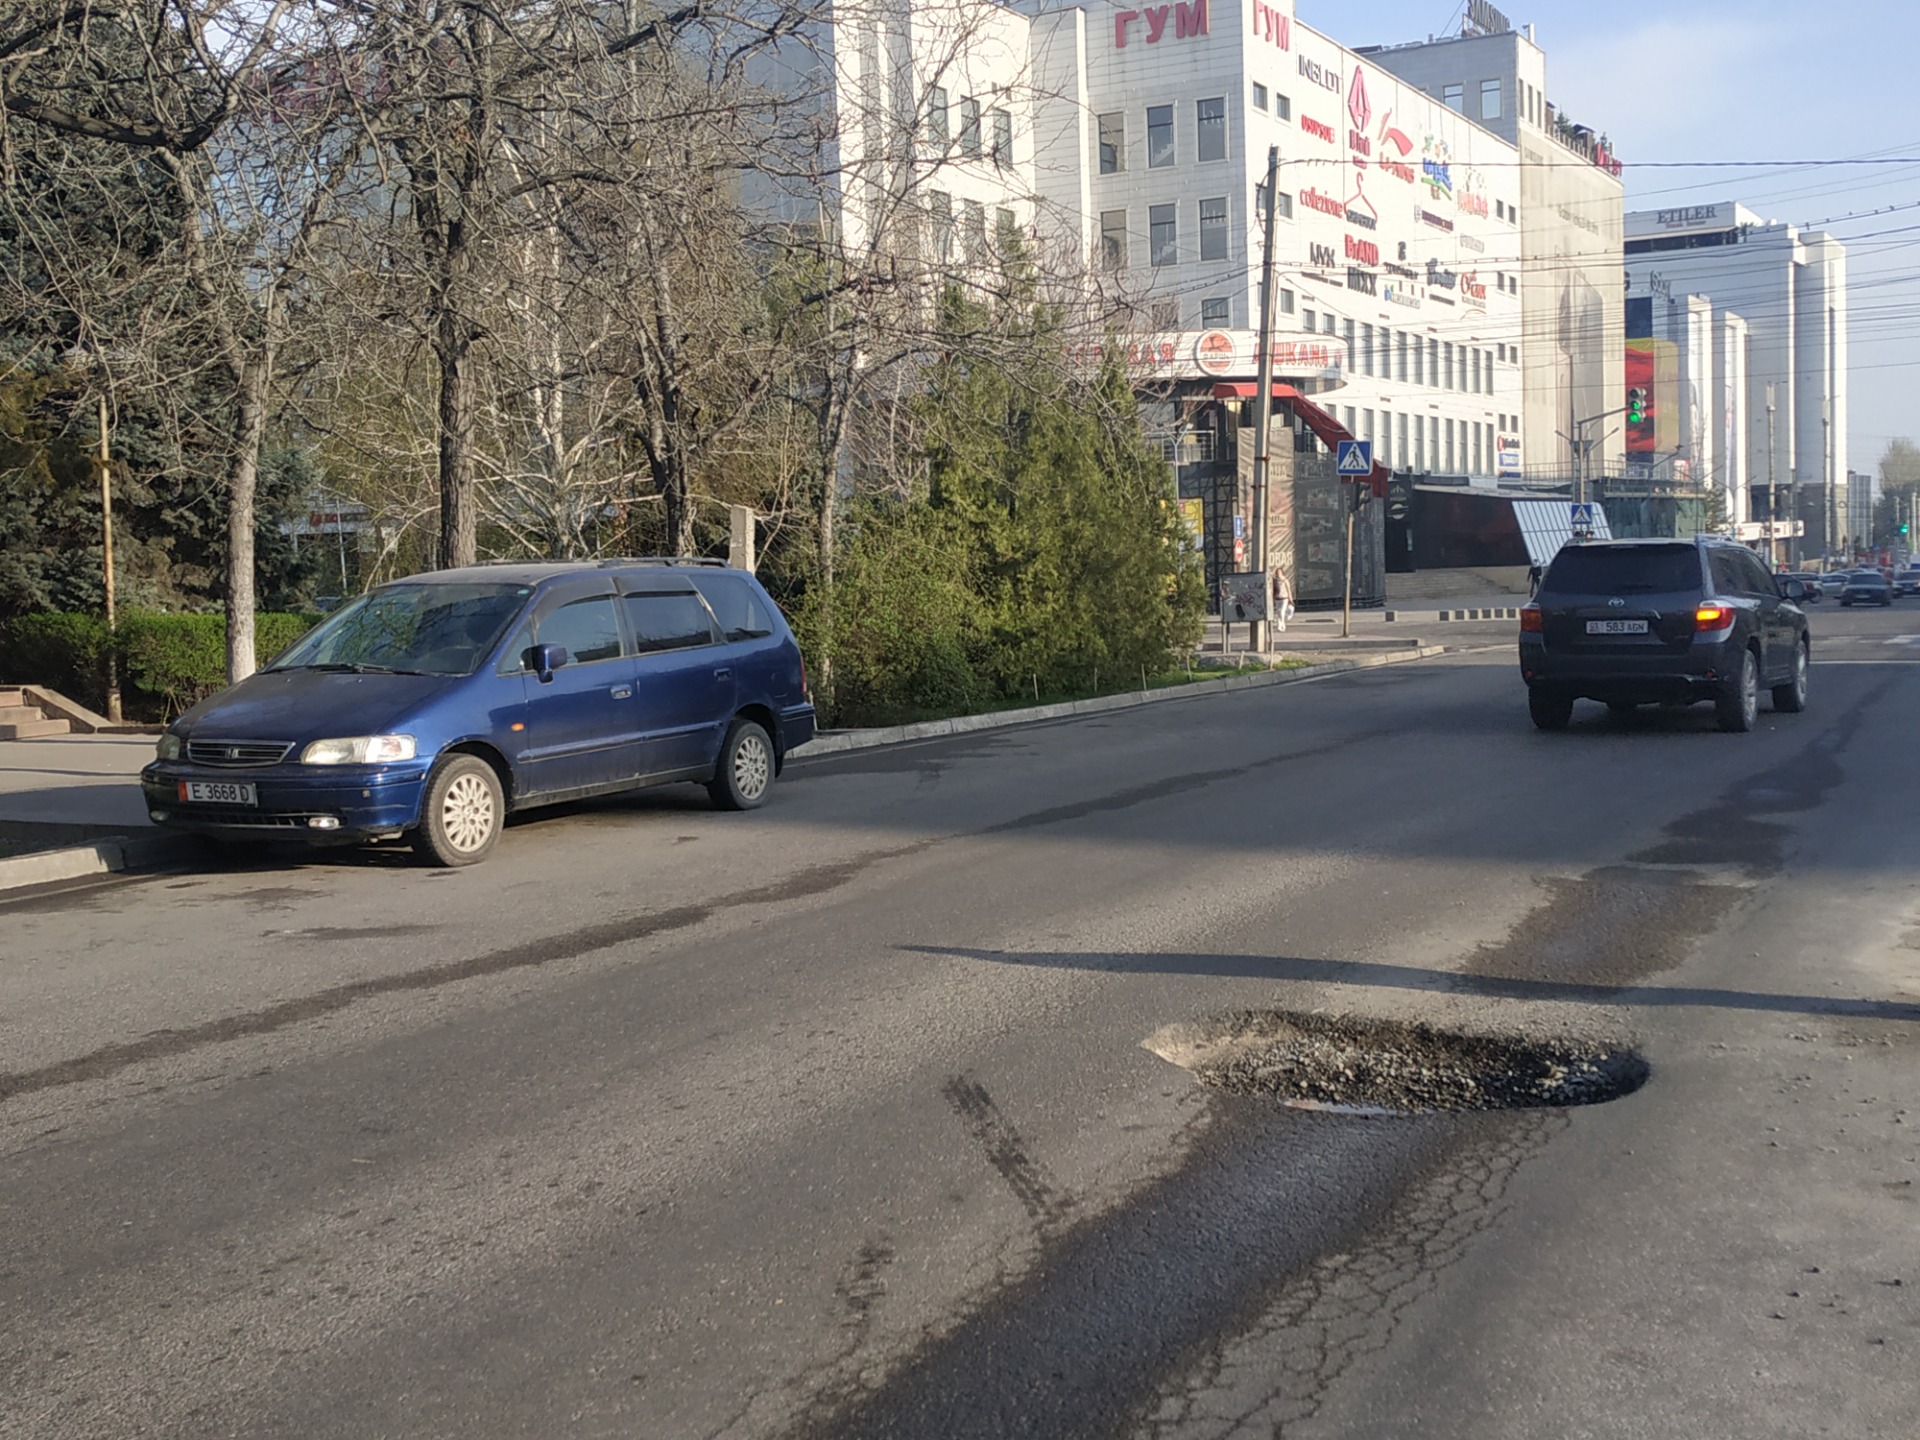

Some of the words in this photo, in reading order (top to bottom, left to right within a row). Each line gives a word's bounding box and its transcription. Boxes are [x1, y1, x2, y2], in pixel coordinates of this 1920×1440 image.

[1115, 0, 1209, 48] ГУМ
[1253, 0, 1289, 52] ГУМ
[1656, 206, 1717, 224] ETILER
[1243, 551, 1293, 566] СОВАЯ
[1606, 622, 1625, 632] 583
[192, 784, 203, 799] E
[204, 784, 237, 800] 3668
